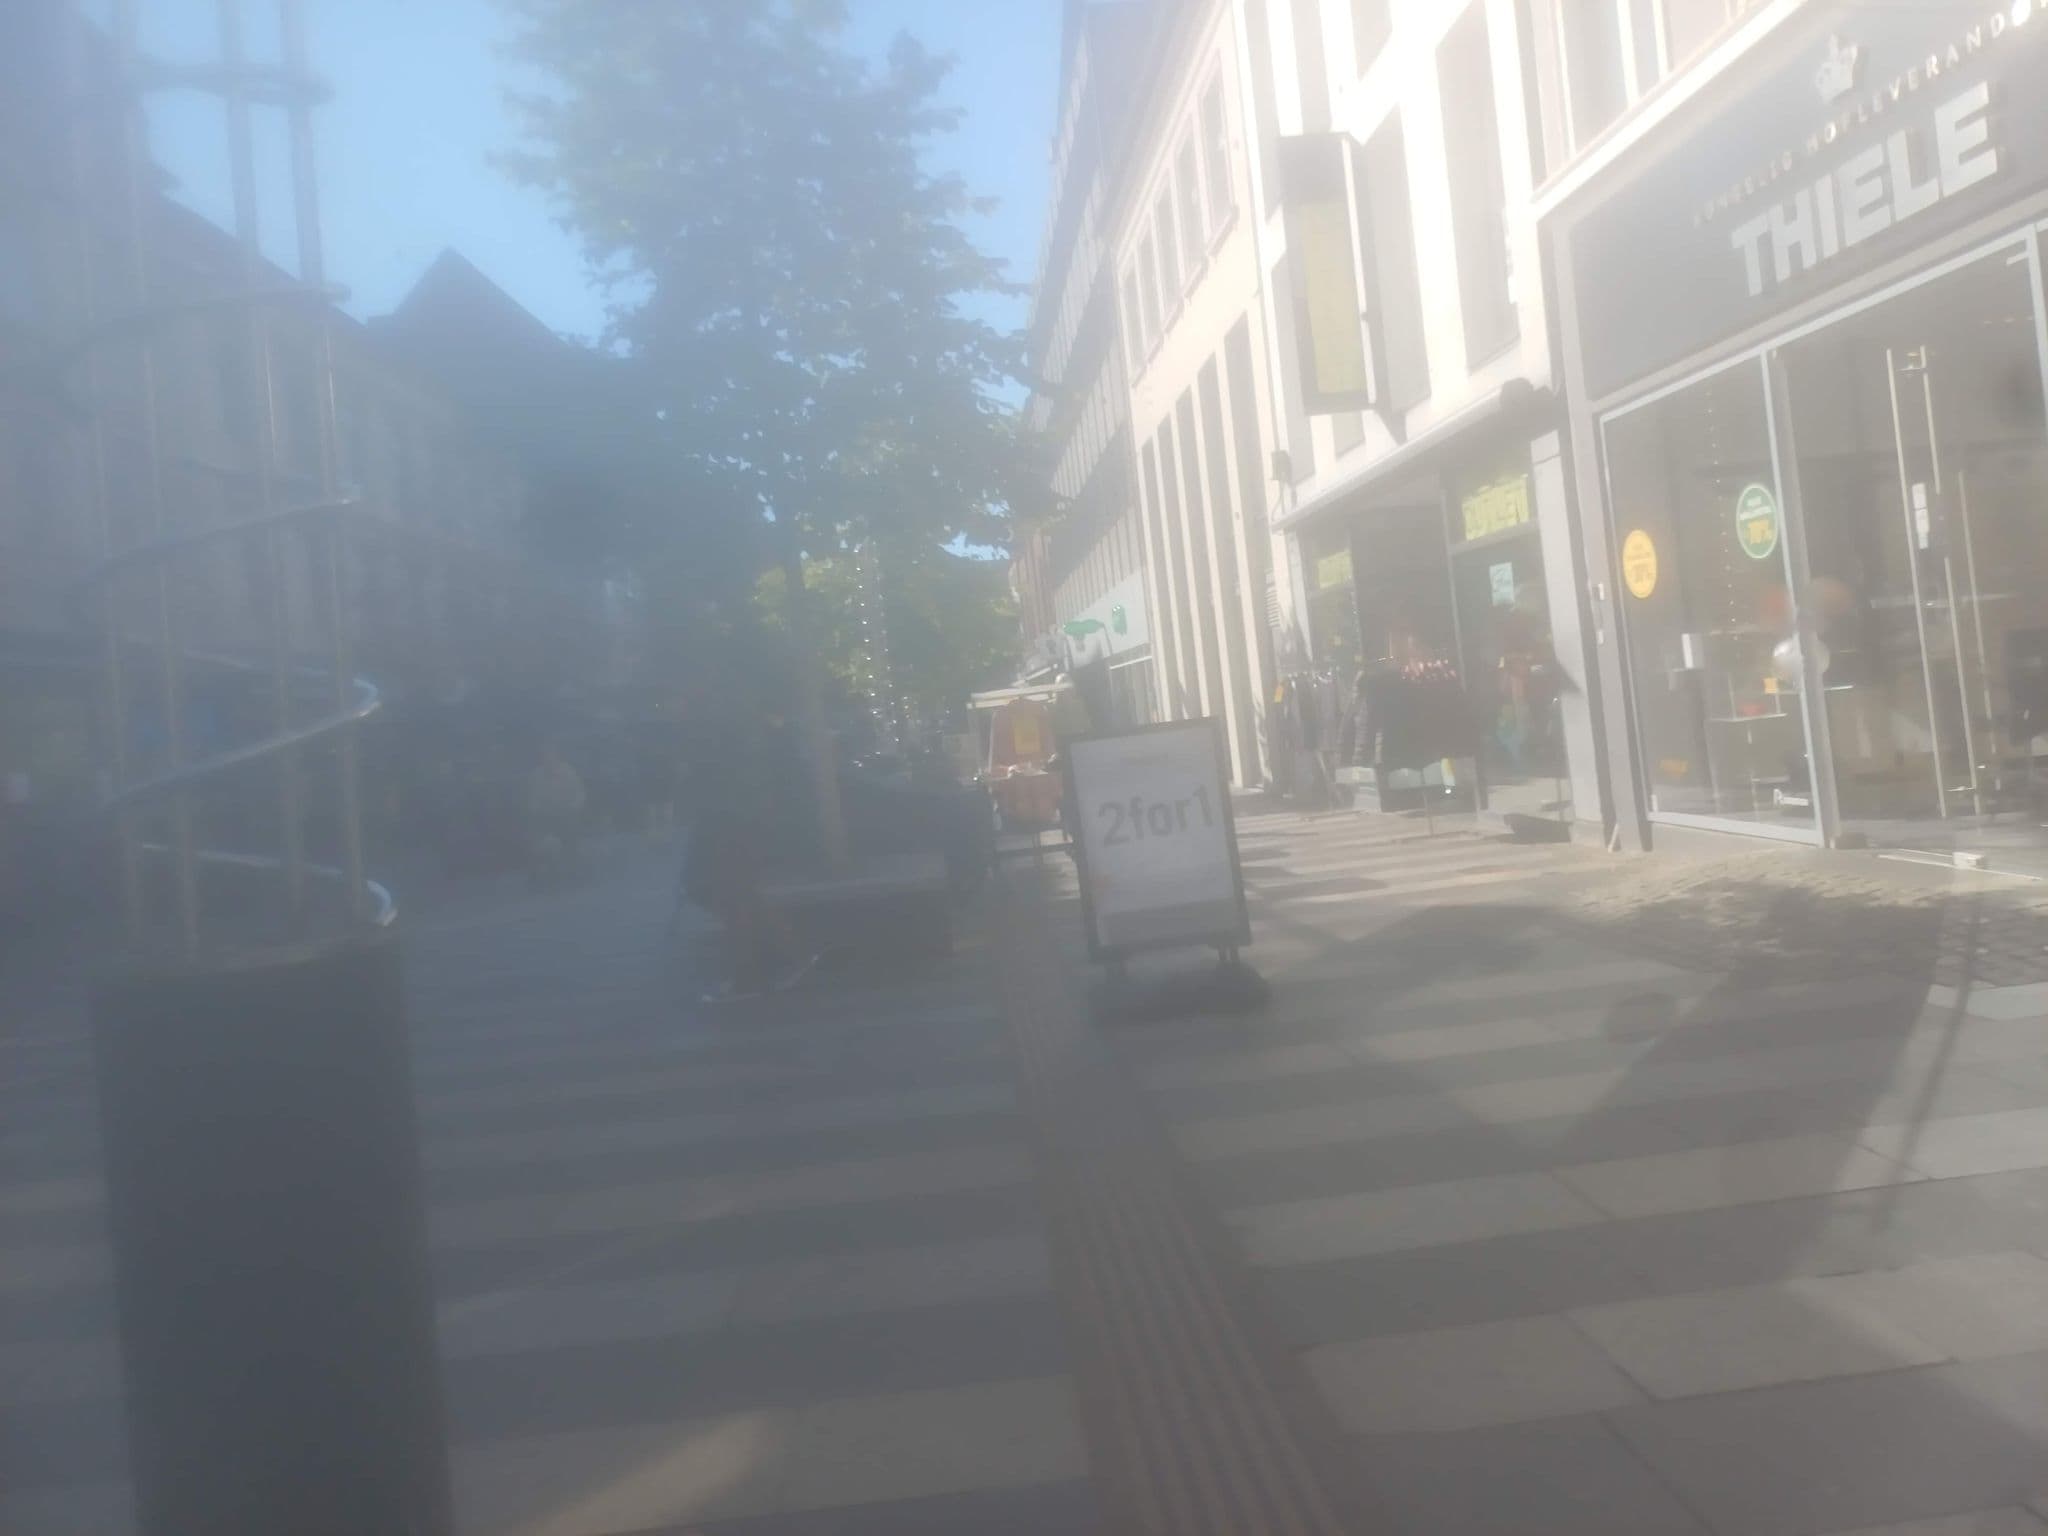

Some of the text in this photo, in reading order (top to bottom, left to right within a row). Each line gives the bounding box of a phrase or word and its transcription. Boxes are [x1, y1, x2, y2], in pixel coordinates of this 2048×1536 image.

[1805, 0, 2048, 156] HOFLEVERAND
[1731, 81, 1998, 297] THIELE
[1099, 784, 1214, 847] 2for1
